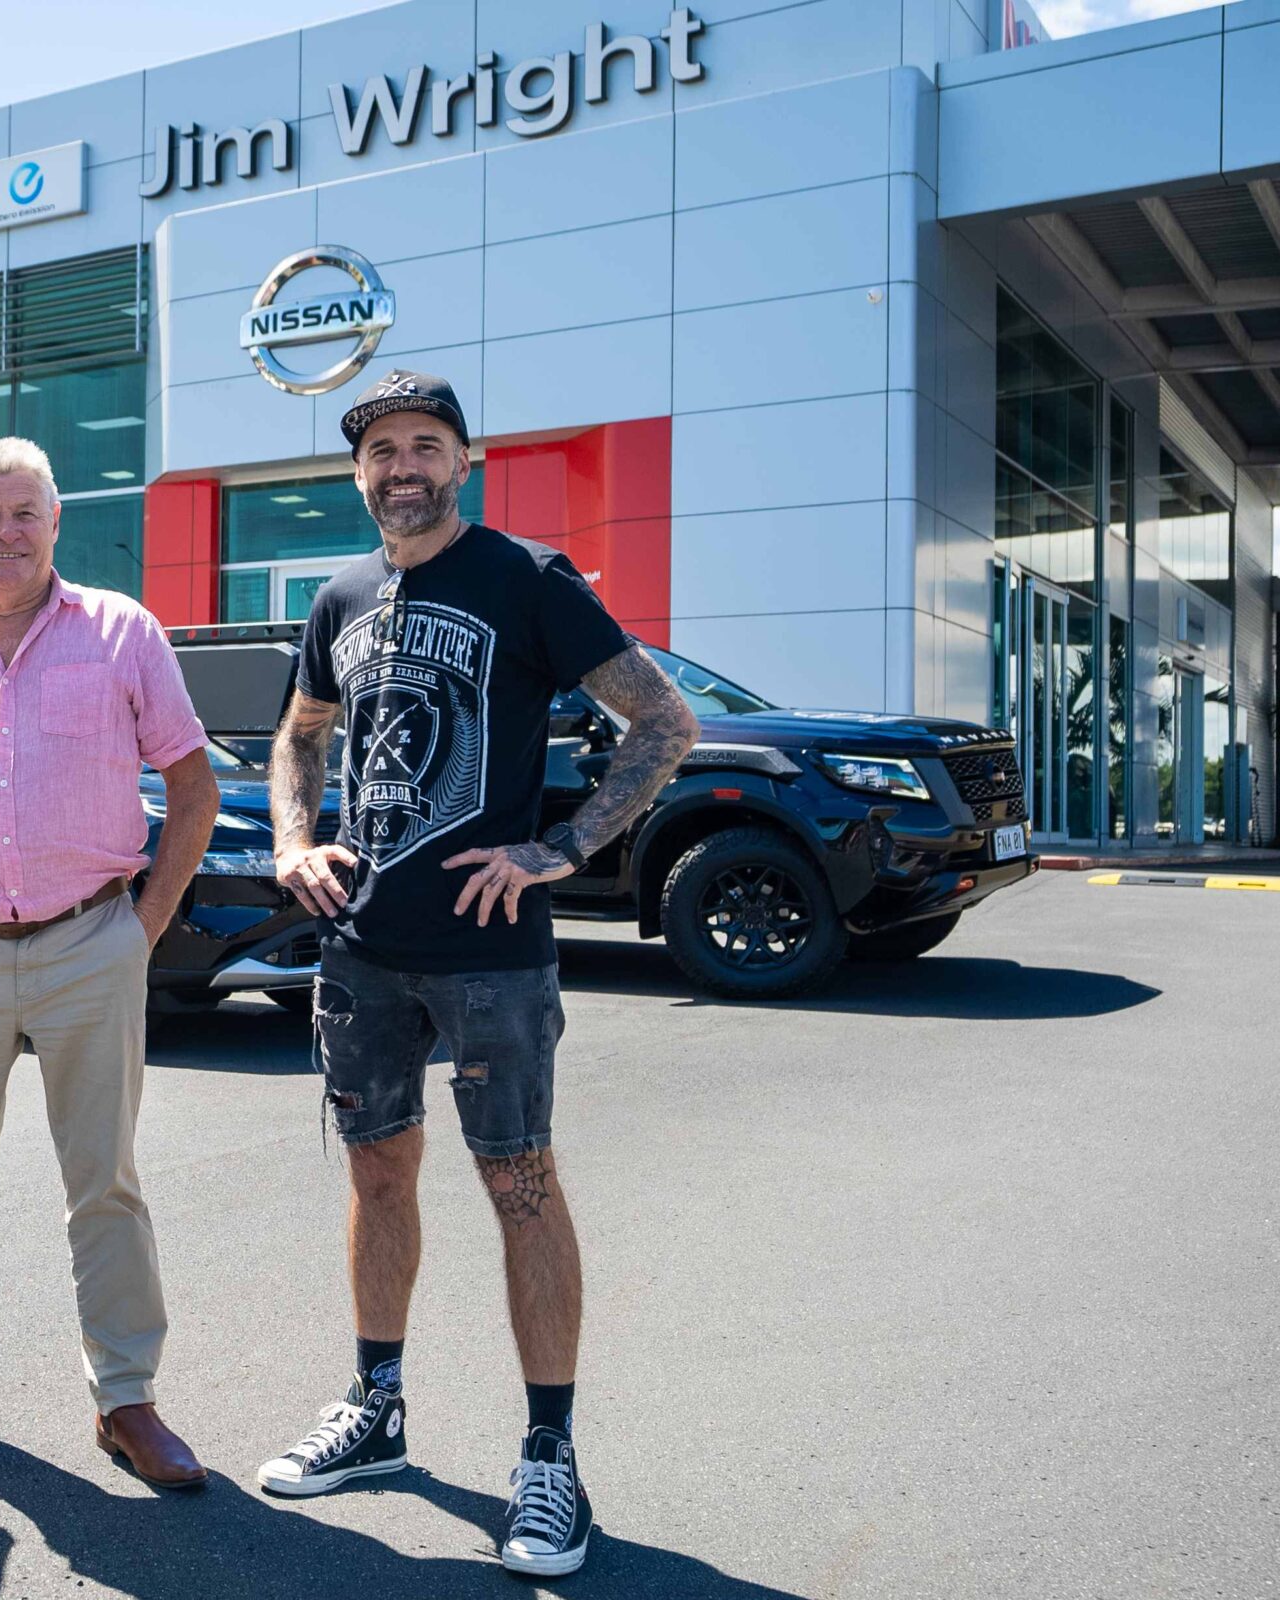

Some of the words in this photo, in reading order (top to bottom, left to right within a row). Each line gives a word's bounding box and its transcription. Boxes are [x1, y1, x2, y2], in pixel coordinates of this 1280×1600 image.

[139, 117, 291, 198] Jim
[326, 7, 706, 155] Wright
[250, 299, 374, 338] NISSAN
[396, 667, 437, 684] ZEALAND
[939, 730, 1009, 743] NAVARA
[997, 834, 1012, 854] FNA
